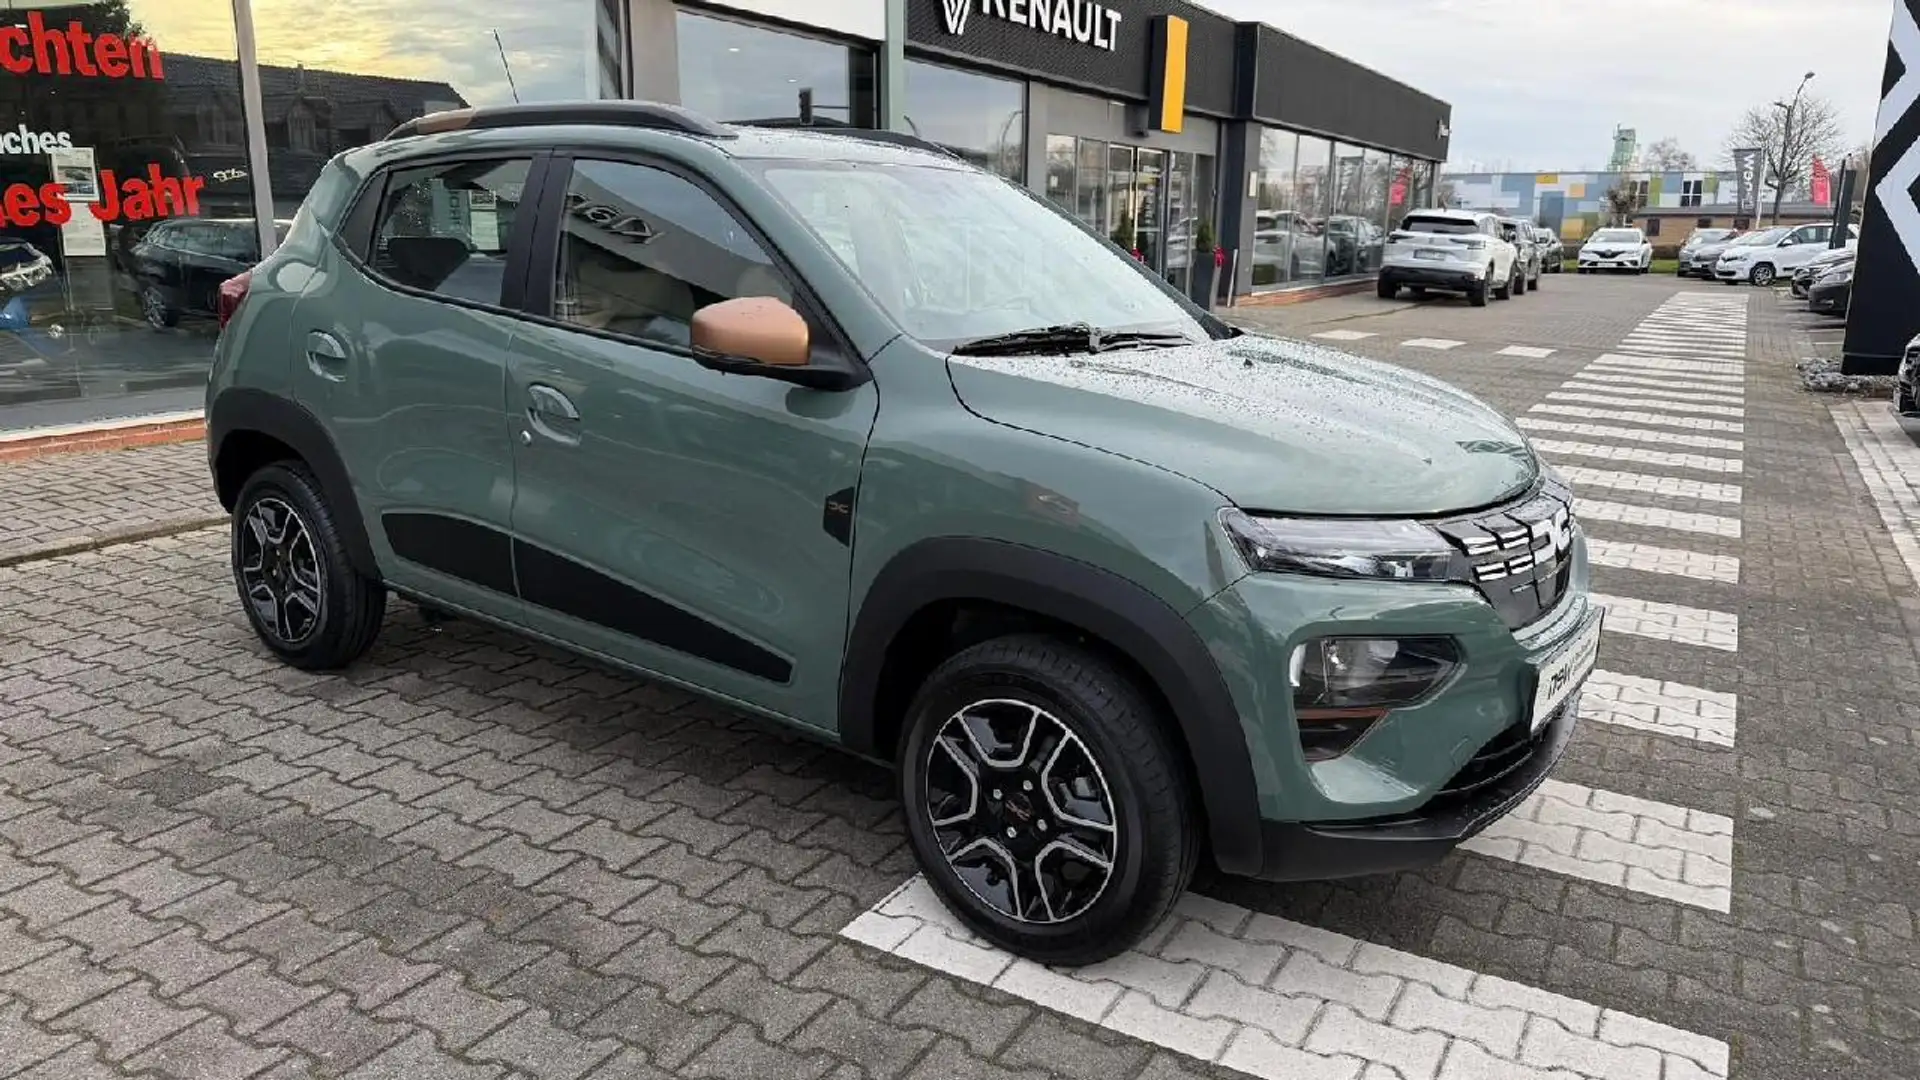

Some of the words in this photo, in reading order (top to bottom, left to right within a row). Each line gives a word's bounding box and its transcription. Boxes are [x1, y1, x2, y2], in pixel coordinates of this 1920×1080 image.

[0, 11, 164, 79] chten
[0, 124, 72, 154] ches
[0, 183, 72, 227] es
[88, 161, 206, 221] Jahr
